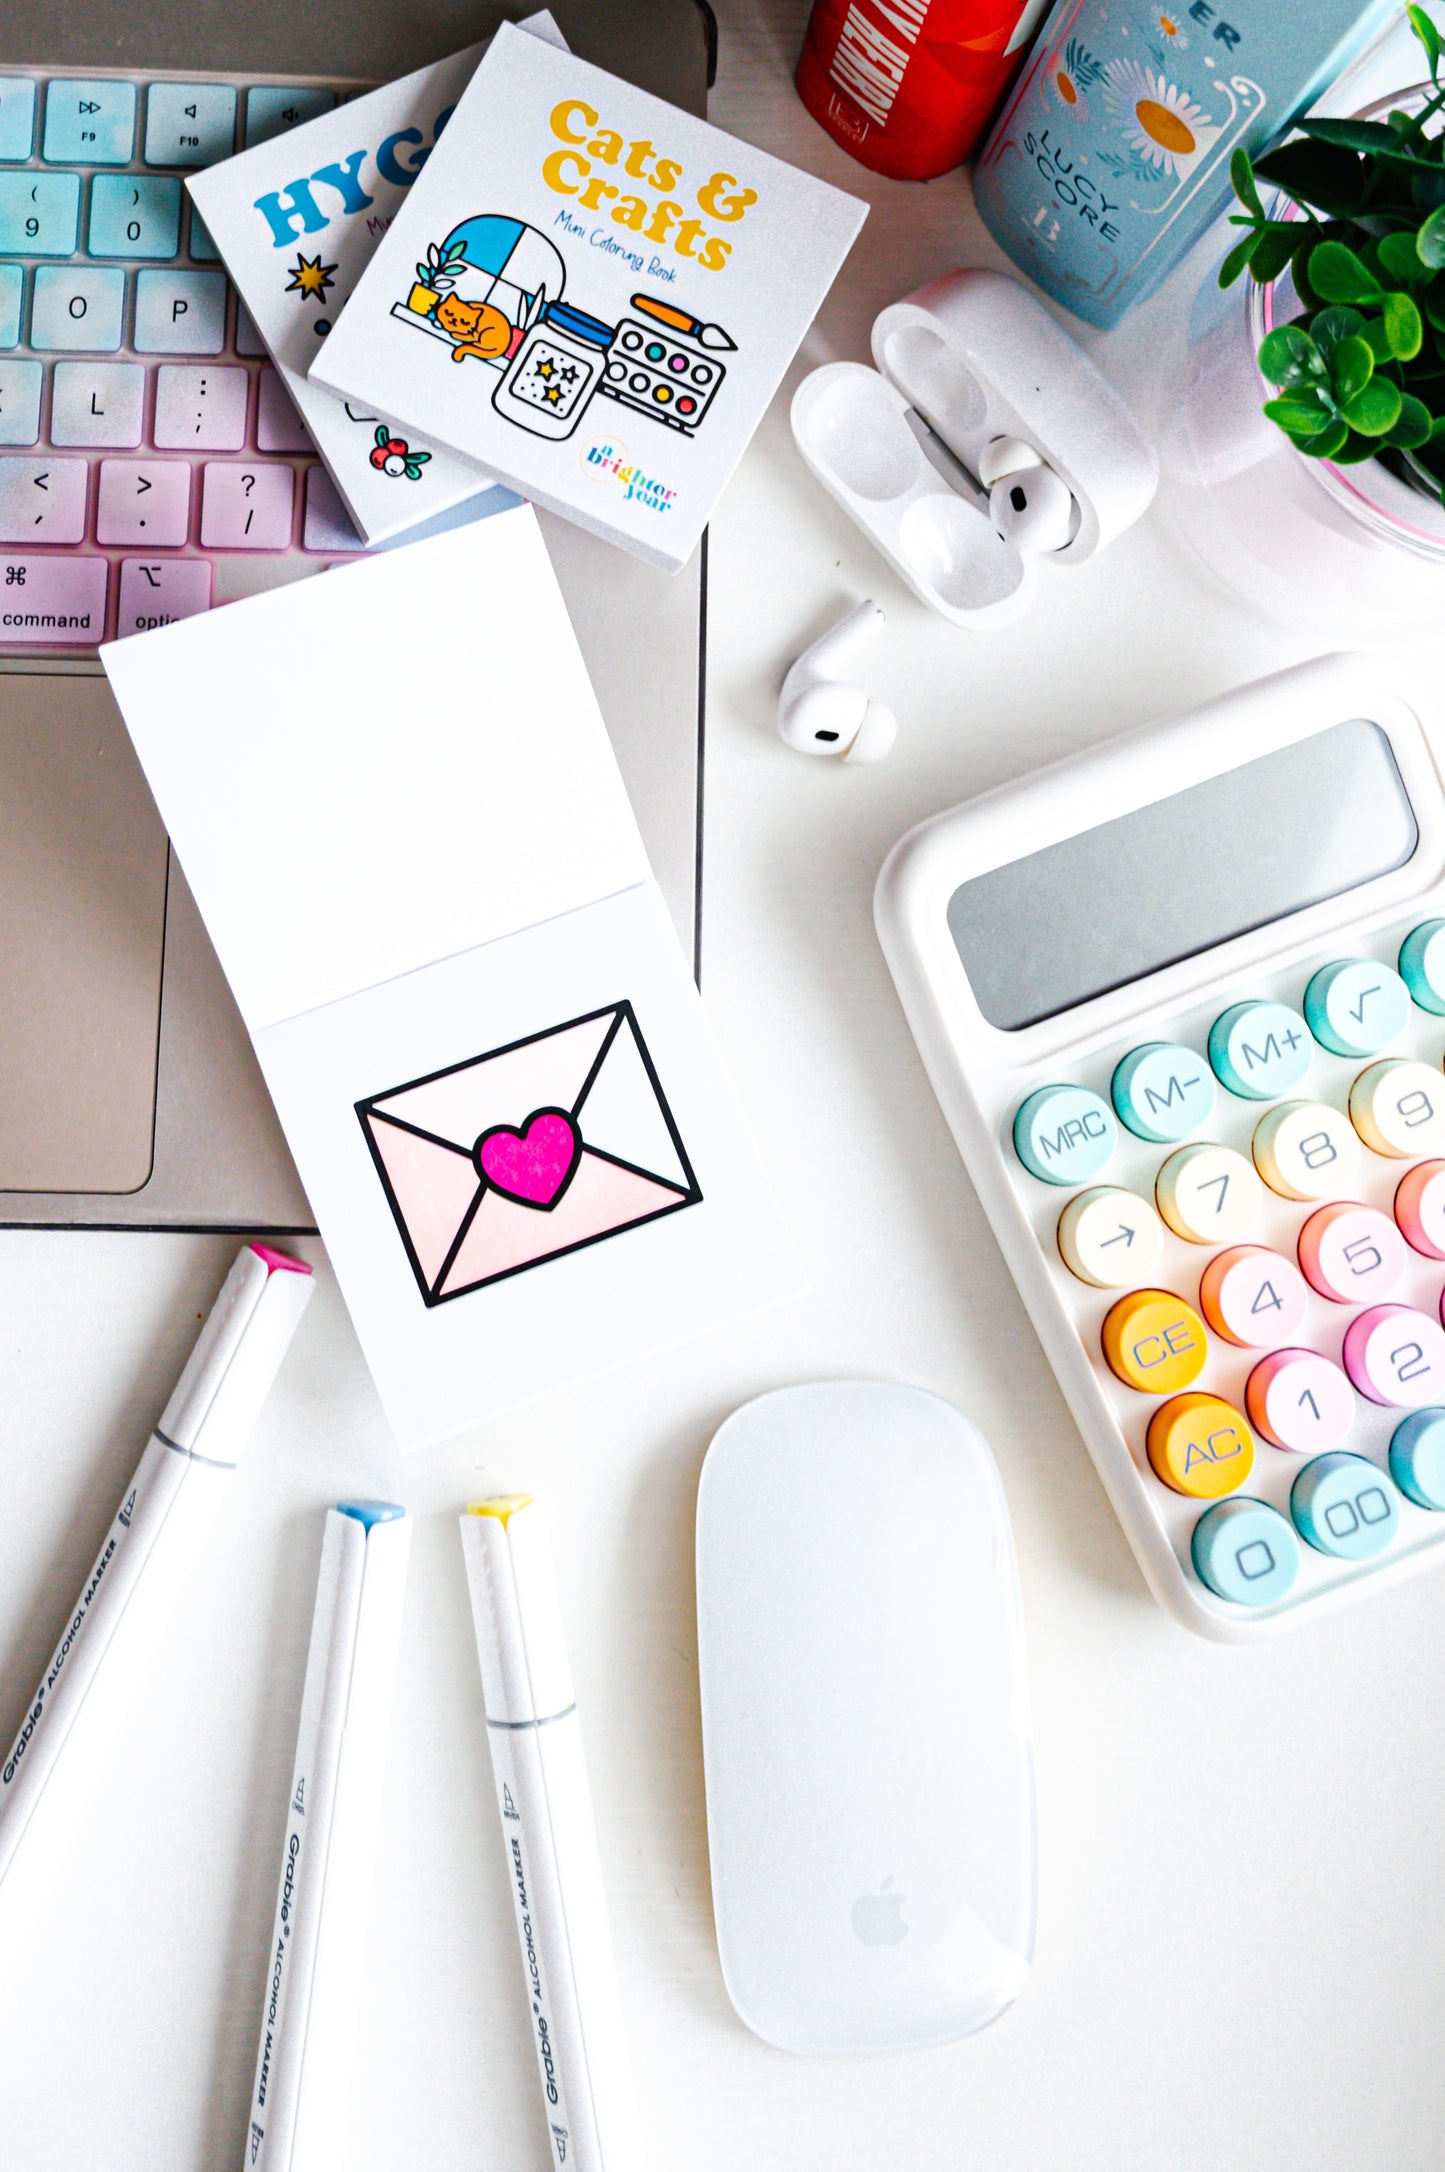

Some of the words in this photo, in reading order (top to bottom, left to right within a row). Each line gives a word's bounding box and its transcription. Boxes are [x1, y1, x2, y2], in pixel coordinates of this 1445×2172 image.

[829, 2, 910, 127] HENRY
[81, 131, 96, 142] F9
[179, 136, 199, 147] F10
[253, 104, 458, 249] HYG
[549, 99, 683, 193] Cats
[696, 172, 759, 223] &
[1040, 129, 1120, 213] LUCY
[1023, 131, 1122, 244] SCORE
[25, 217, 40, 238] 9
[126, 221, 141, 241] 0
[541, 149, 733, 272] Crafts
[553, 209, 586, 239] Mini
[589, 228, 645, 272] Coloring
[646, 255, 678, 283] Book
[68, 296, 88, 320] O
[172, 299, 189, 323] P
[91, 392, 105, 416] L
[587, 447, 678, 501] brighter
[623, 484, 672, 513] year
[2, 613, 91, 630] command
[135, 613, 180, 631] opti
[1241, 1028, 1302, 1070] M+
[1396, 1090, 1434, 1128] 9
[1038, 1110, 1107, 1160] MRC
[1298, 1131, 1338, 1170] 8
[1196, 1174, 1230, 1213] 7
[1342, 1234, 1383, 1276] 5
[1250, 1280, 1283, 1315] 4
[1133, 1321, 1195, 1369] CE
[1390, 1342, 1432, 1383] 2
[1298, 1388, 1321, 1421] 1
[1184, 1428, 1242, 1475] AC
[1324, 1487, 1392, 1539] 00
[1235, 1540, 1276, 1581] 0
[47, 1609, 86, 1688] ALCOHOL
[84, 1538, 118, 1606] MARKER
[510, 1838, 530, 1910] MARKER
[522, 1915, 543, 2000] ALCOHOL
[267, 1937, 285, 2026] ALCOHOL
[257, 2031, 274, 2107] MARKER
